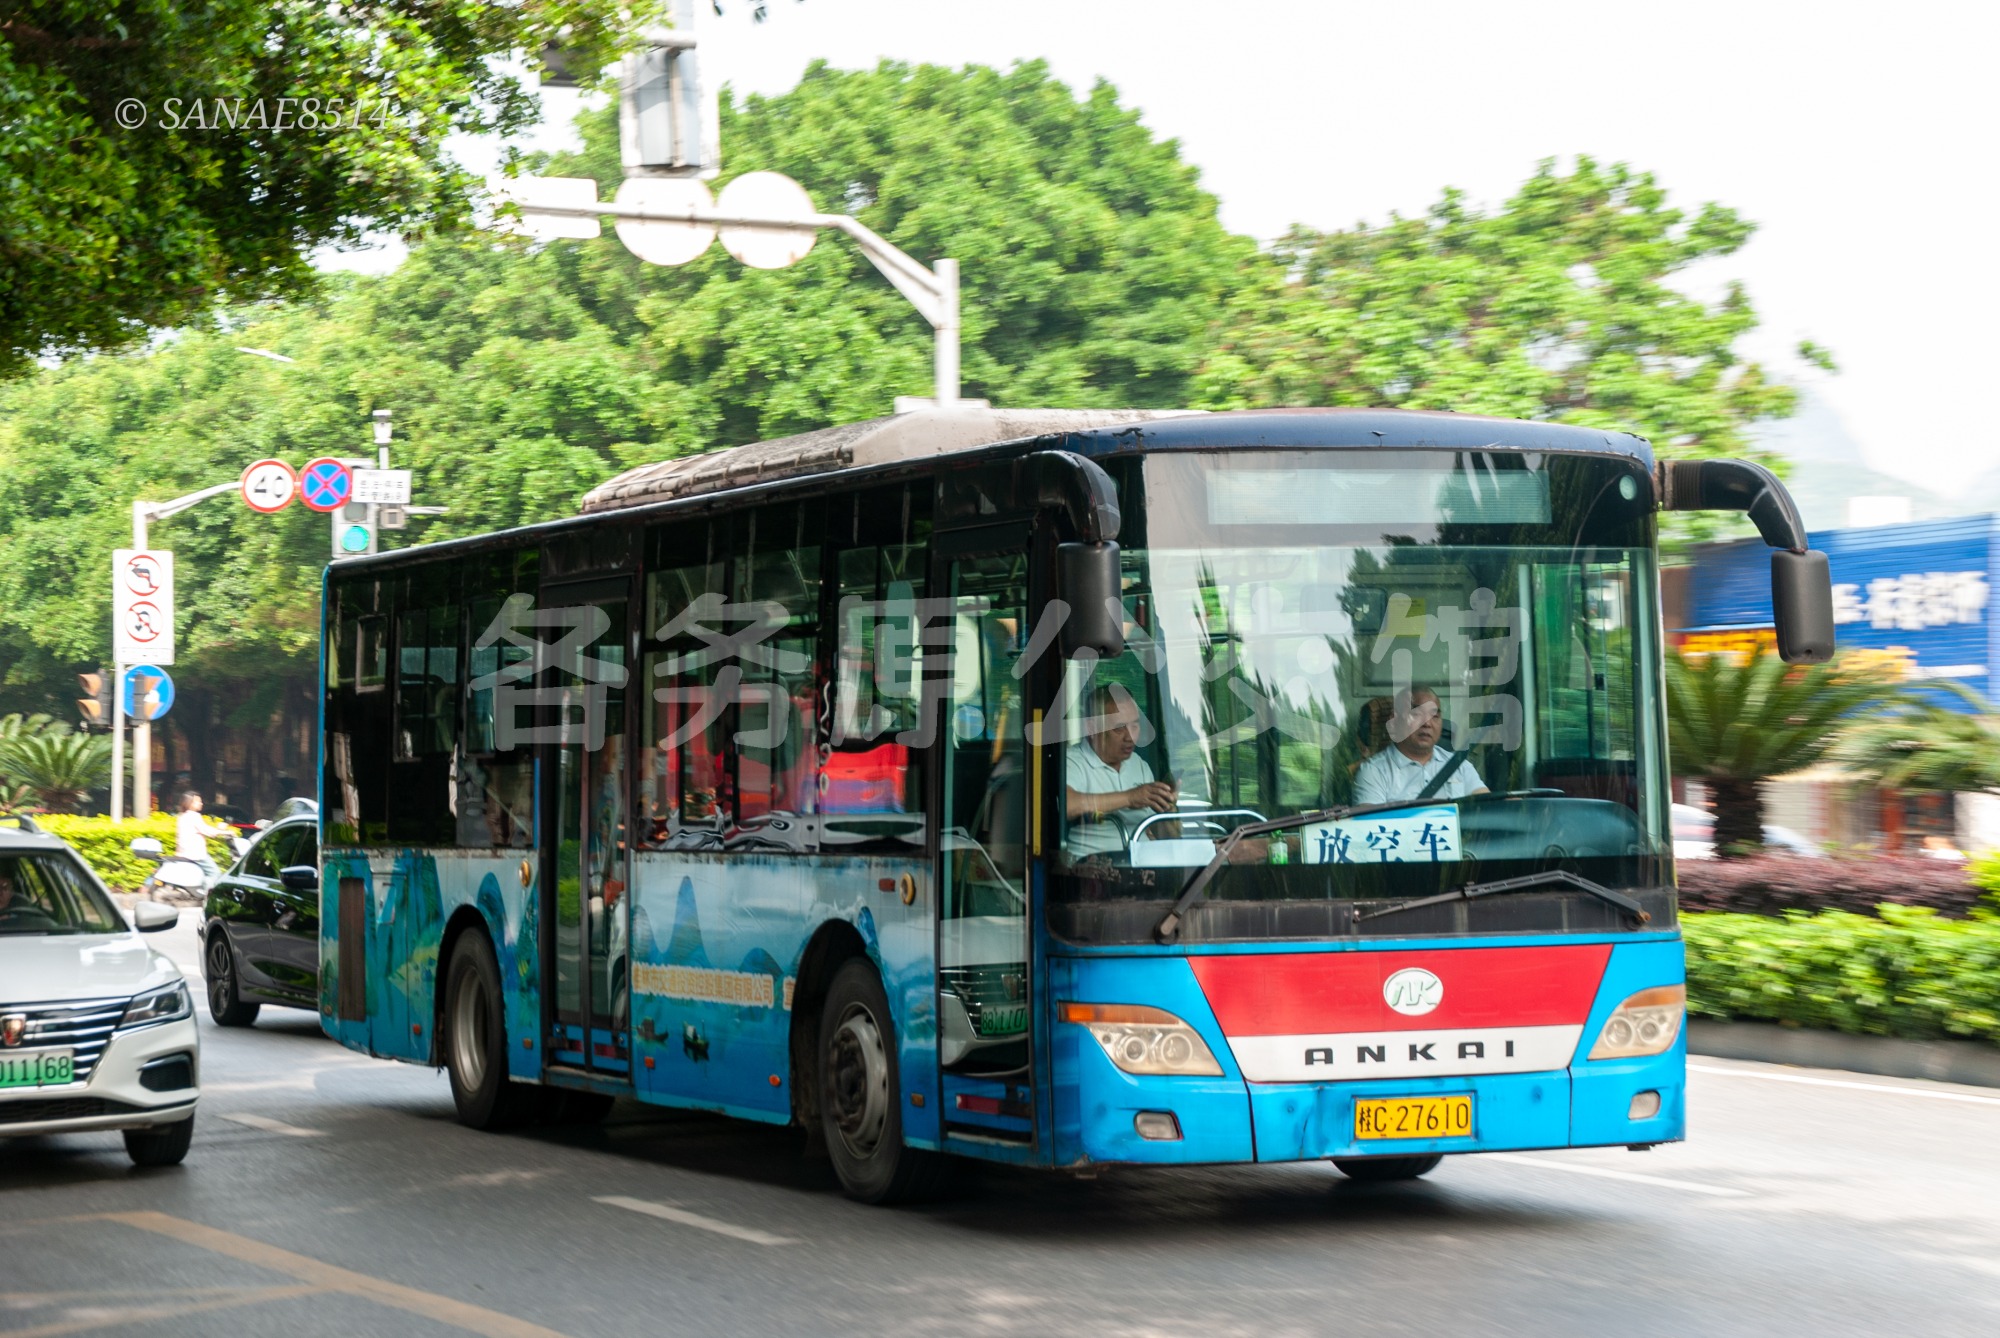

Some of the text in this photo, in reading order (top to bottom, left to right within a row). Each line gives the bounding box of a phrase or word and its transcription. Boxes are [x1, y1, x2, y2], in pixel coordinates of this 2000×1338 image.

[254, 475, 287, 499] 40
[1314, 822, 1452, 864] 放空车
[1304, 1040, 1514, 1066] ANKAI
